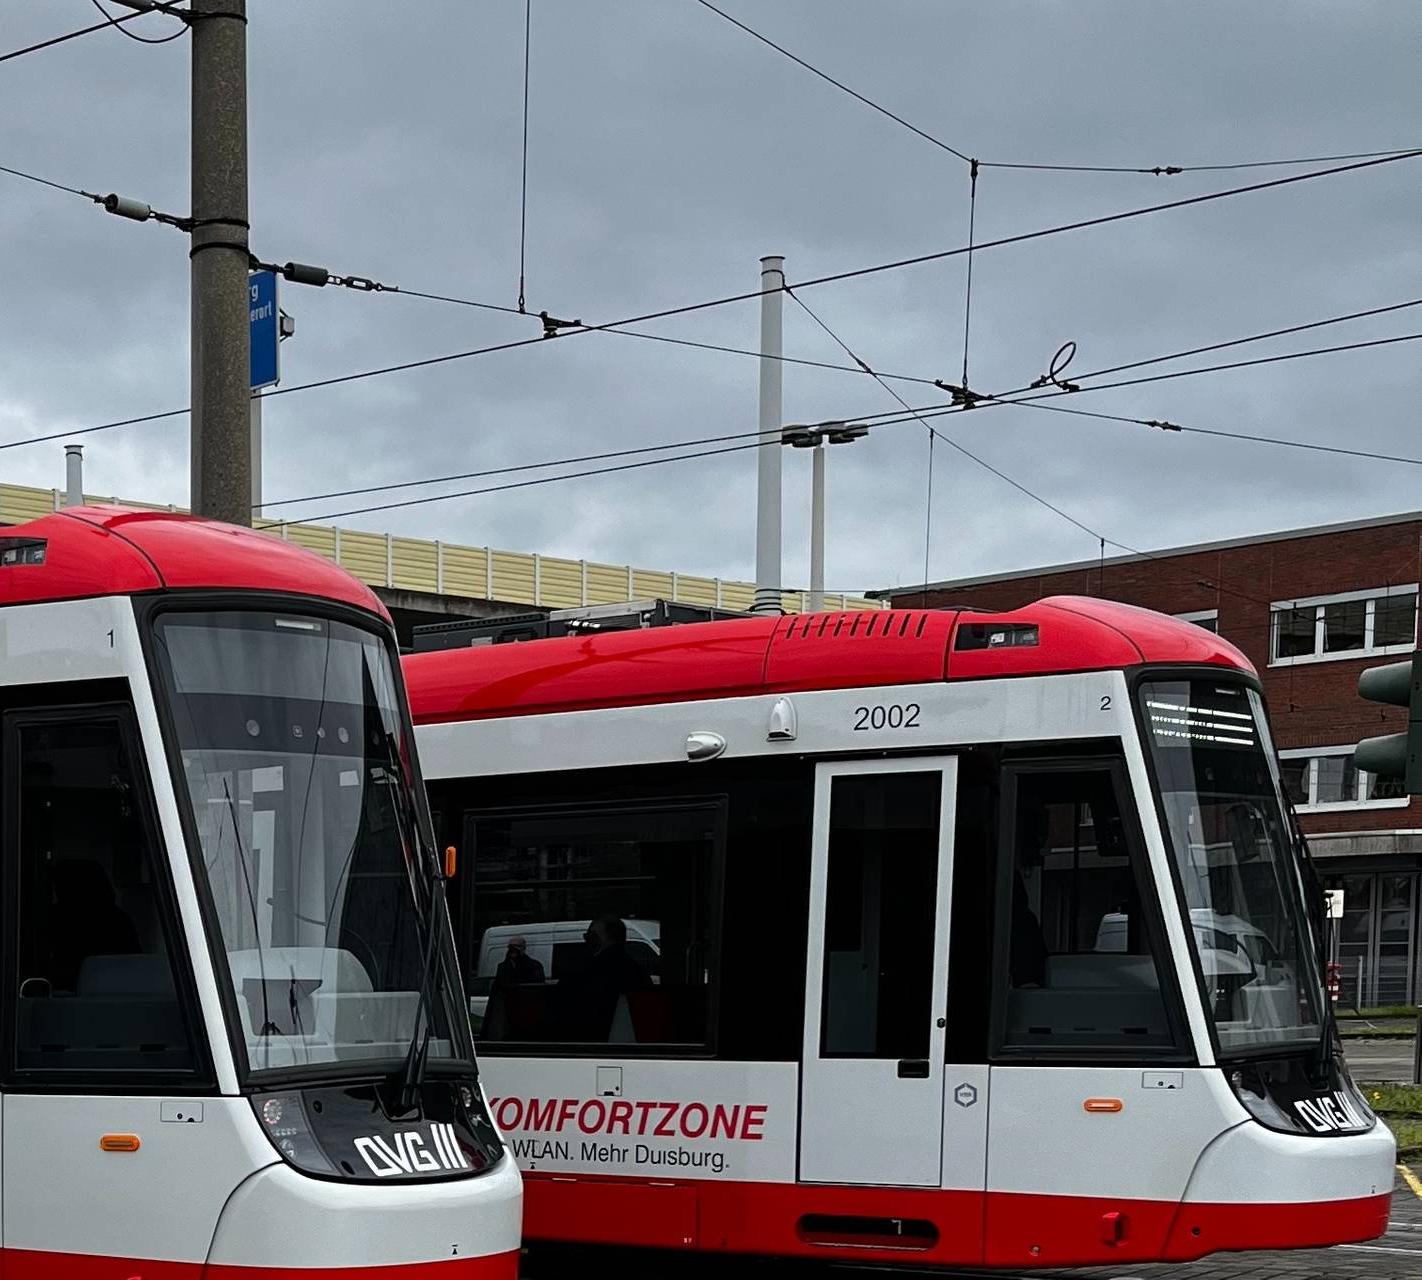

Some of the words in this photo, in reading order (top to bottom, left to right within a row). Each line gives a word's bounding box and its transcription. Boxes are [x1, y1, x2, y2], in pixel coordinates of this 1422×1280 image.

[106, 629, 114, 648] 1
[1100, 695, 1112, 711] 2
[853, 703, 921, 731] 2002
[512, 1139, 575, 1161] WLAN.
[581, 1142, 629, 1163] Mehr
[635, 1144, 730, 1173] Duisburg.
